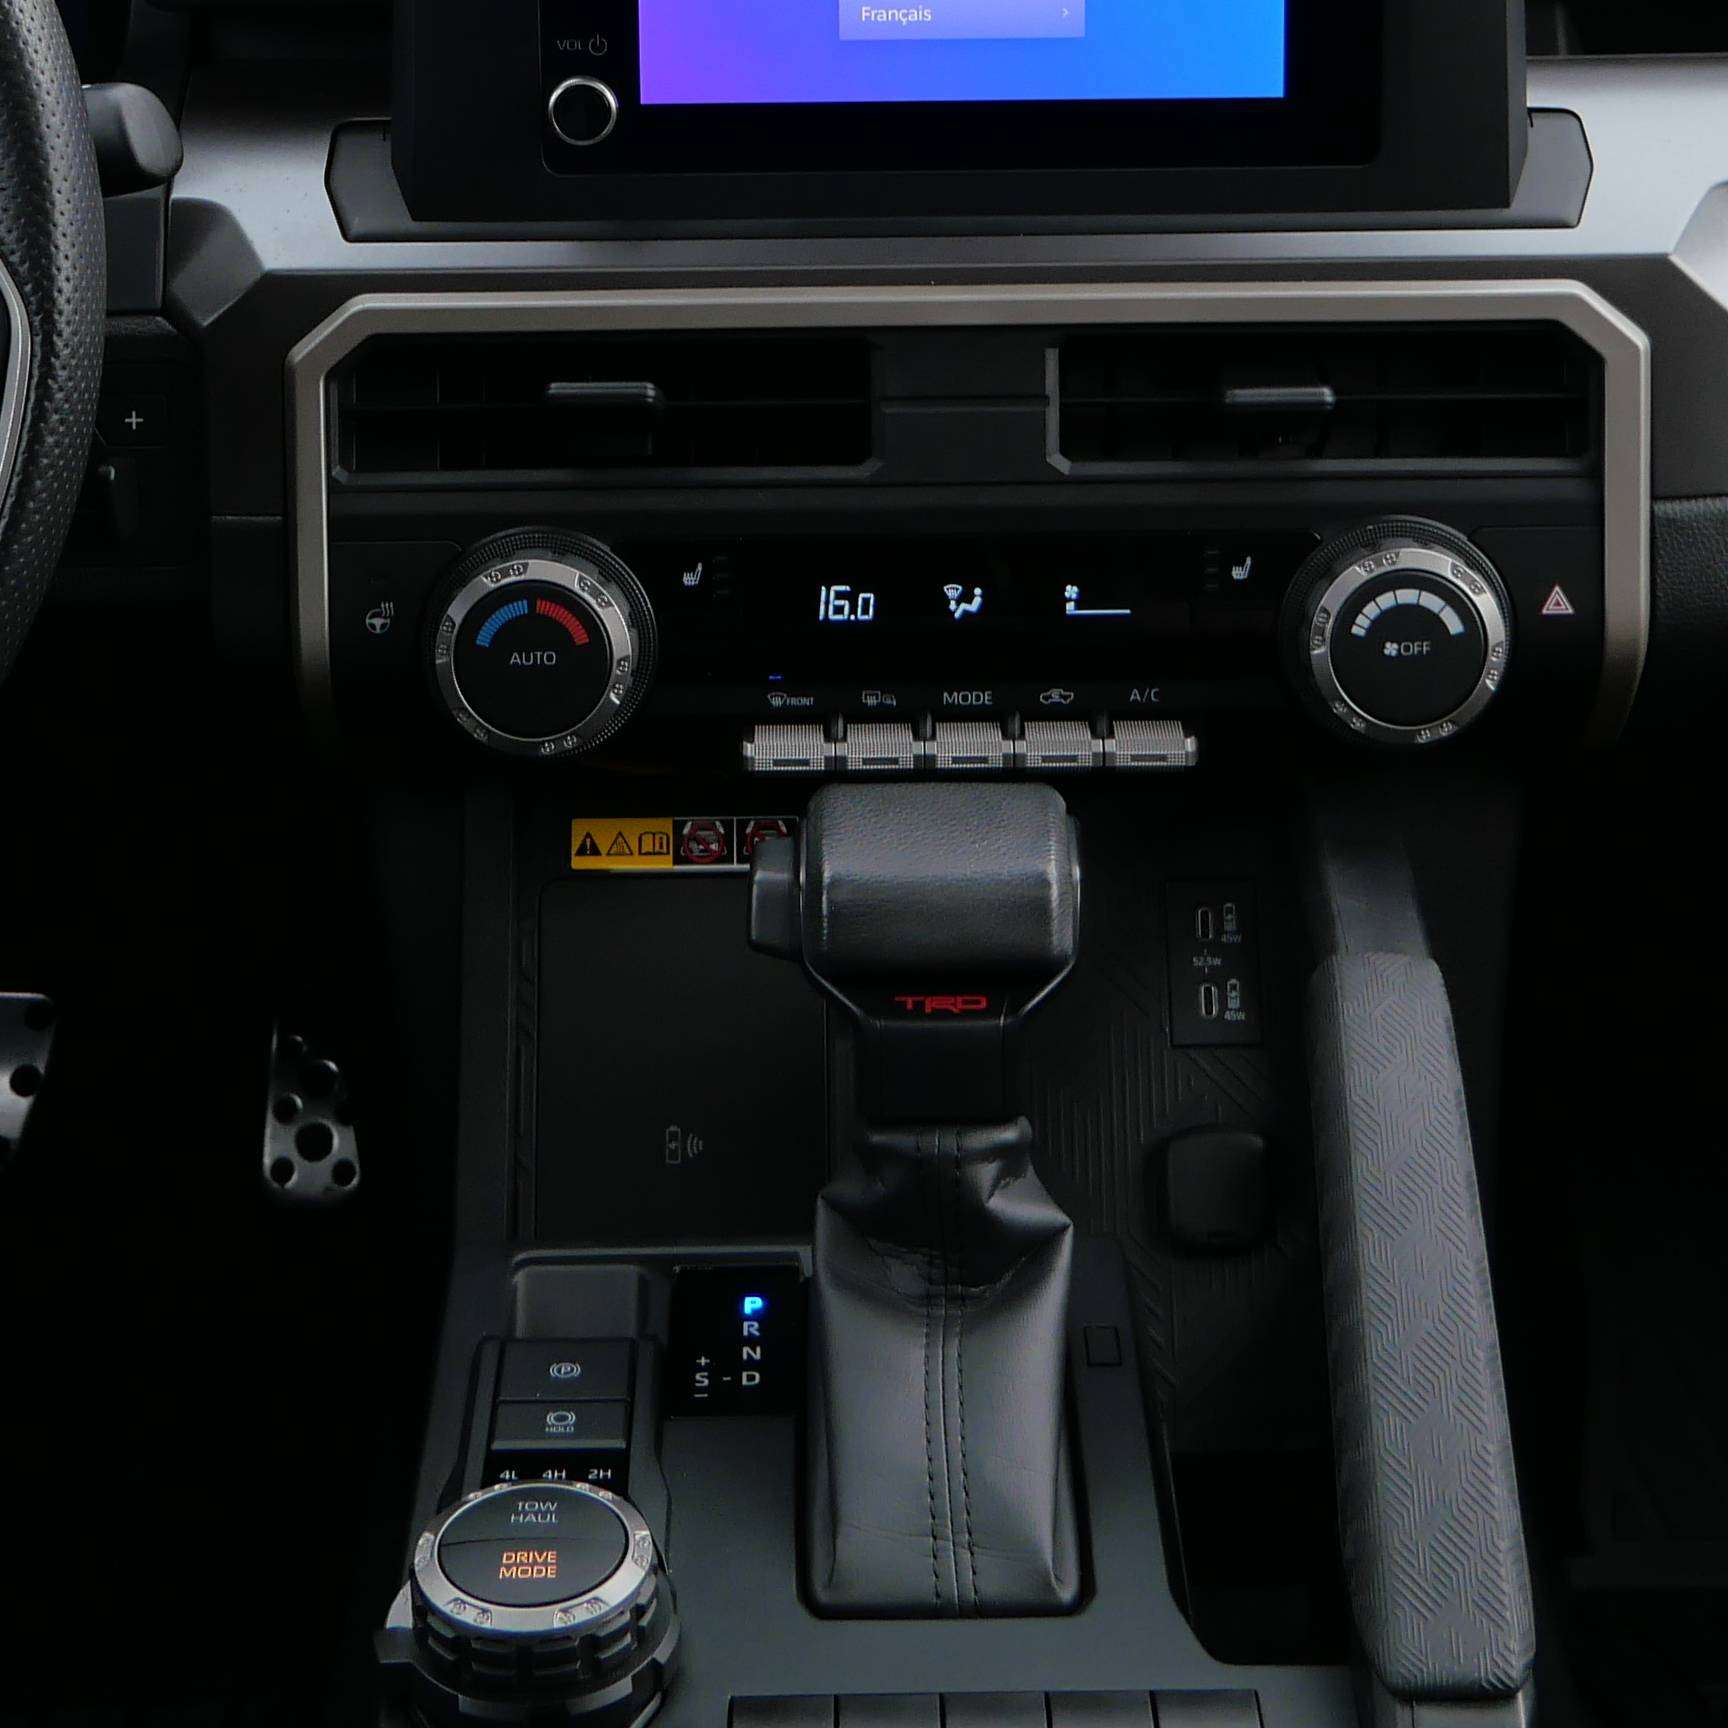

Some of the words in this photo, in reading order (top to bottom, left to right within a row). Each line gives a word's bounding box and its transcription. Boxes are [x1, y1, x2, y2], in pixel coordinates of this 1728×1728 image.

[861, 5, 933, 26] Français
[556, 39, 584, 51] VOL
[818, 584, 875, 622] 16.0
[1400, 641, 1432, 656] OFF
[510, 650, 557, 666] AUTO
[785, 695, 815, 707] FRONT
[942, 690, 994, 706] MODE
[1129, 687, 1161, 703] A/C
[894, 995, 987, 1014] TRD
[1224, 1010, 1247, 1022] 45W
[743, 1295, 764, 1315] P
[742, 1320, 761, 1337] R
[742, 1345, 762, 1361] N
[694, 1371, 710, 1387] S
[741, 1370, 761, 1386] D
[545, 1425, 576, 1433] HOLD
[499, 1469, 520, 1480] 4L
[542, 1469, 567, 1480] 4H
[587, 1468, 612, 1480] 2H
[516, 1501, 559, 1513] TOW
[510, 1512, 560, 1524] HAUL
[501, 1550, 558, 1564] DRIVE
[498, 1565, 558, 1580] MODE
